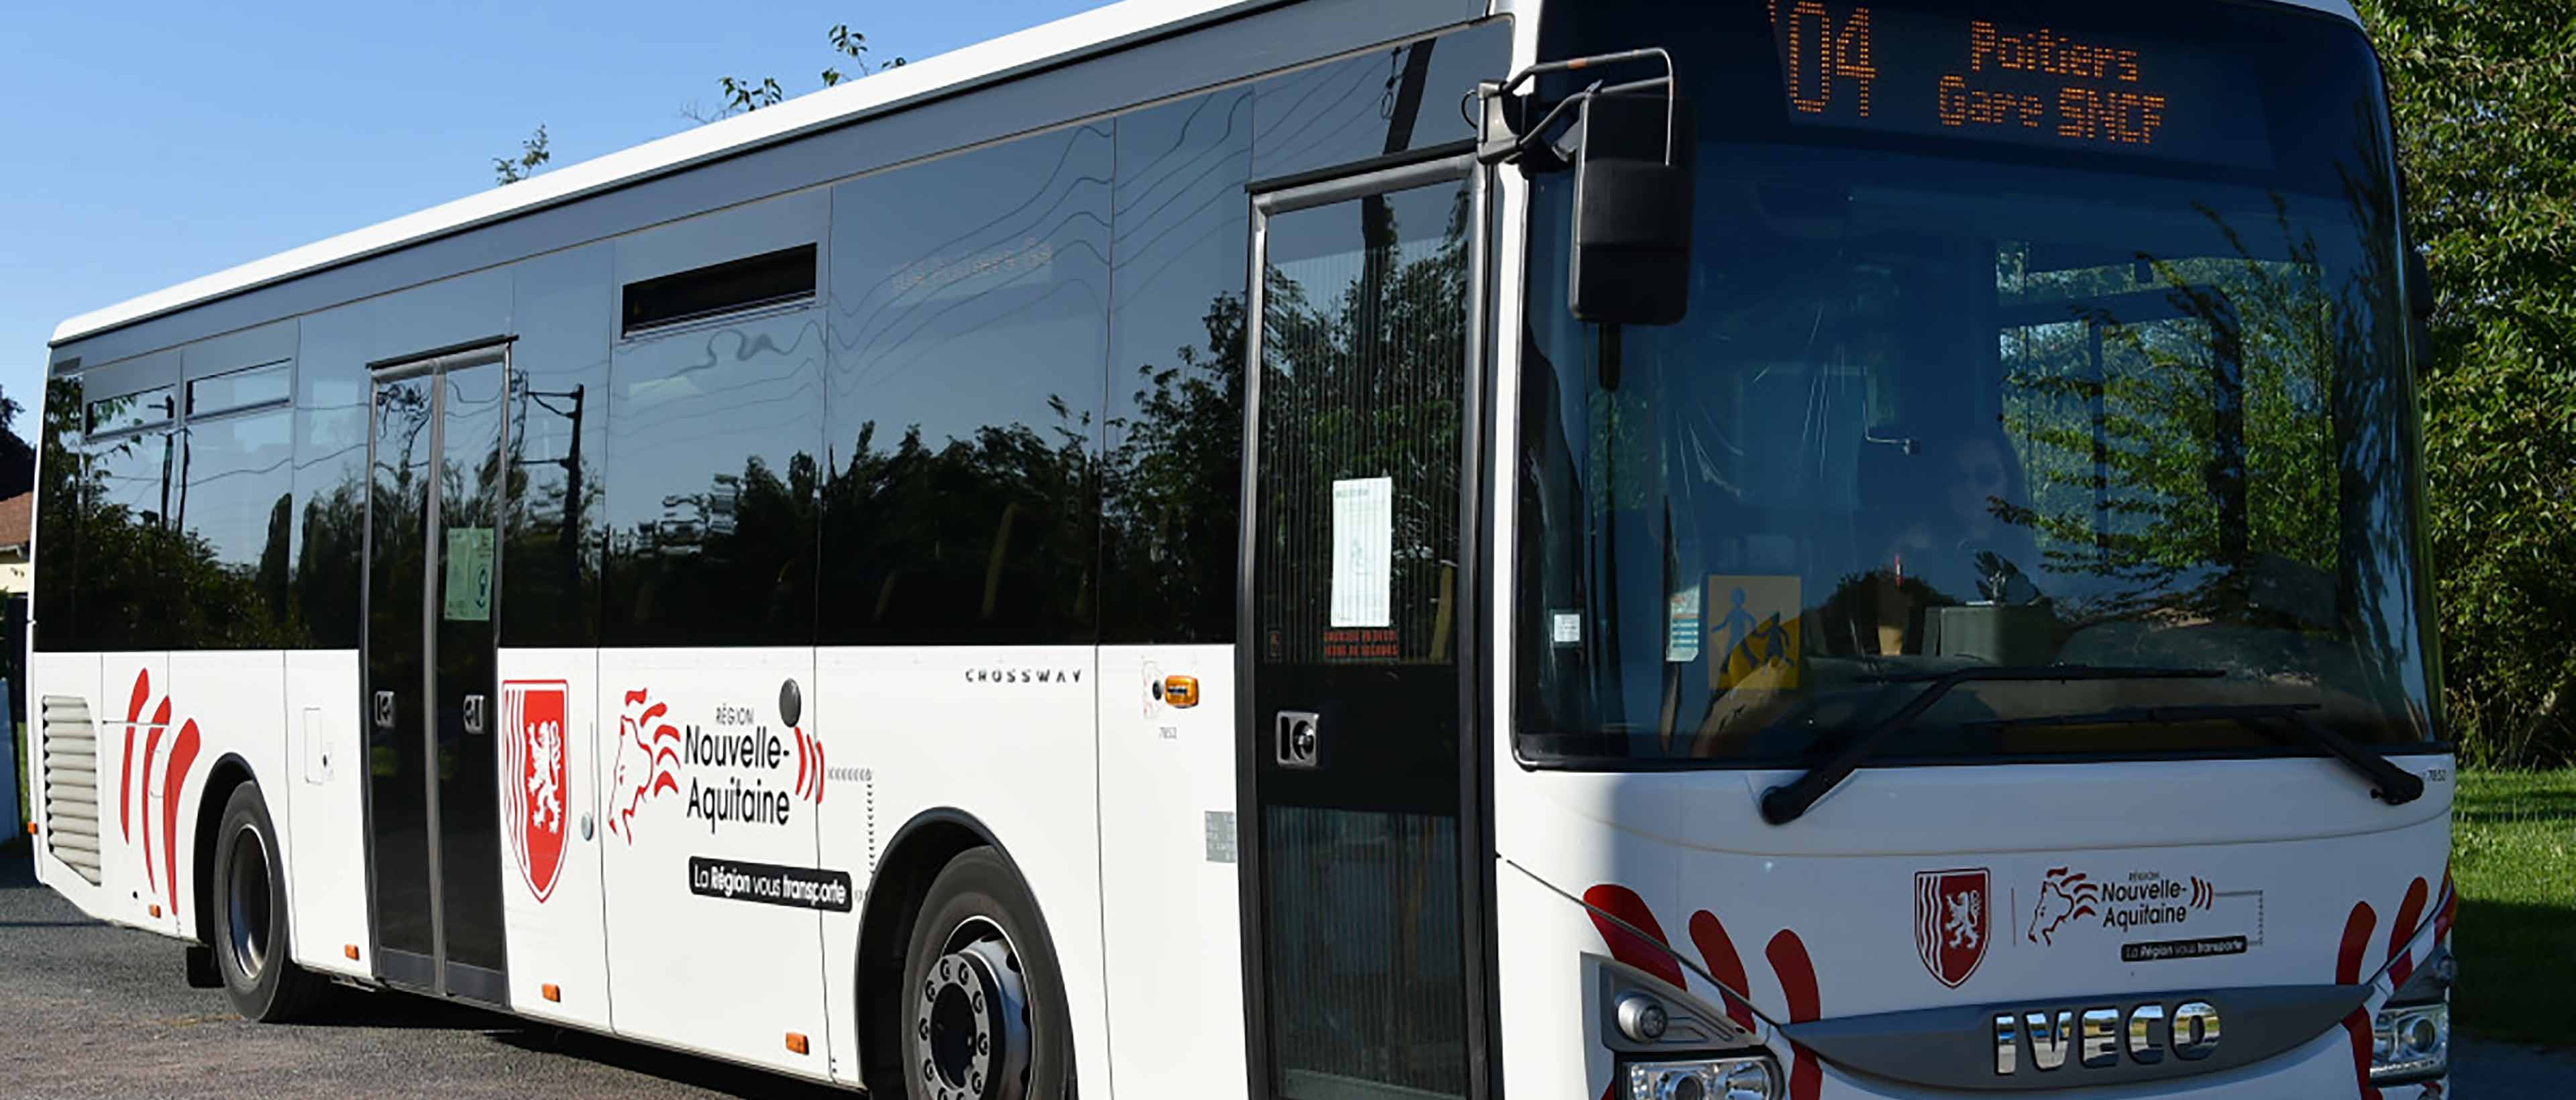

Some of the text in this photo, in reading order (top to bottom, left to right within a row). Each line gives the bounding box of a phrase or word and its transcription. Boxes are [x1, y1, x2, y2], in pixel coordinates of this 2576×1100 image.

[1970, 20, 2139, 82] Poitiers
[1939, 74, 2165, 144] Gare SNCF
[965, 669, 1082, 683] CROSSWAY
[715, 703, 754, 725] RÉGION
[684, 724, 790, 769] Nouvelle-
[687, 776, 790, 834] Aquitaine
[694, 865, 847, 905] La Région vous transporte
[2102, 879, 2188, 902] Nouvelle-
[2102, 903, 2187, 932] Aquitaine
[1993, 999, 2221, 1076] IVECO
